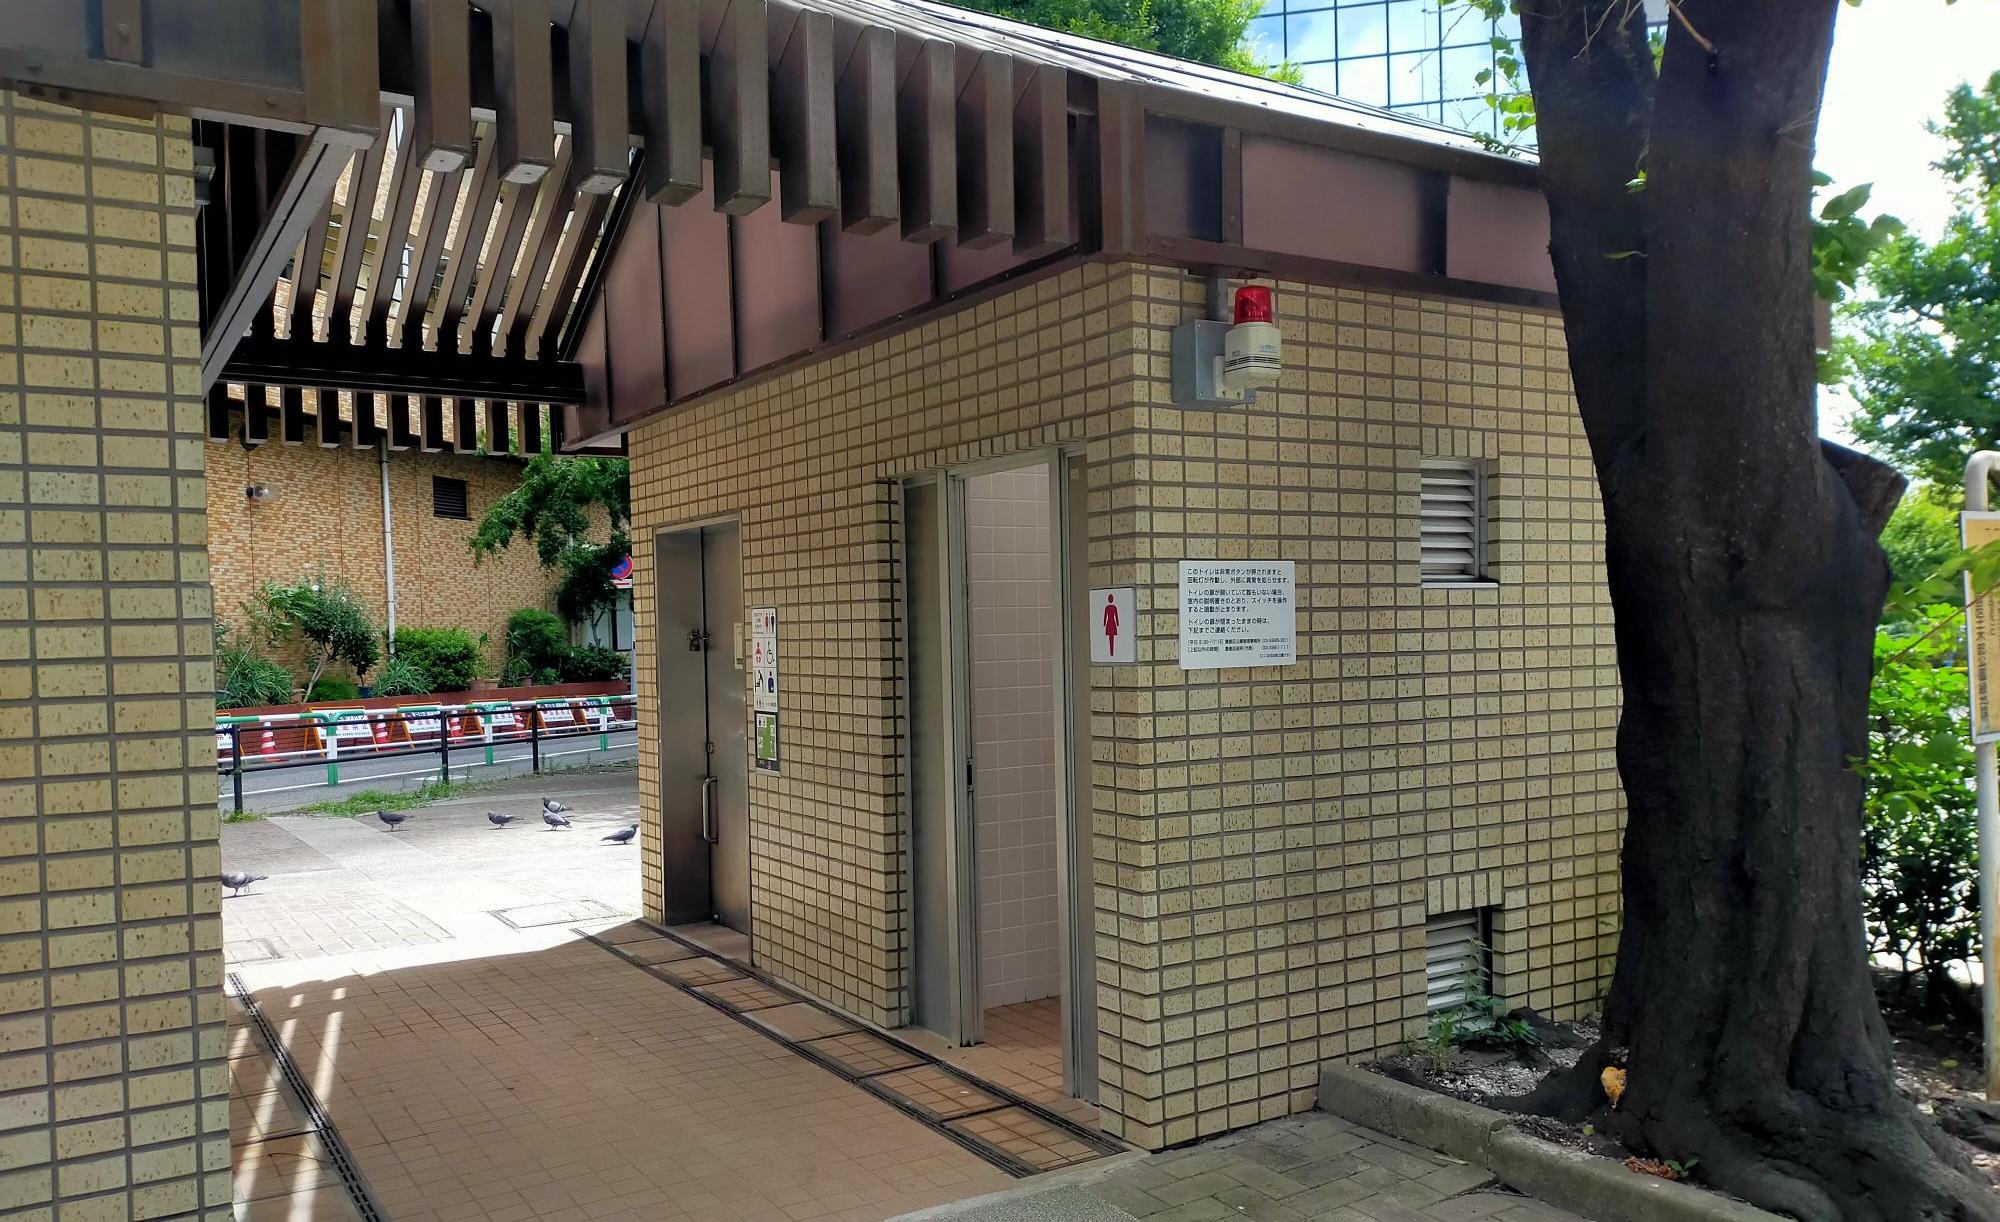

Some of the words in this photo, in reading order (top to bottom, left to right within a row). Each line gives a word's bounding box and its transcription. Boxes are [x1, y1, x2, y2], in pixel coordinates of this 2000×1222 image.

[1187, 568, 1282, 576] このトイレは非常ボタンが押されますと
[1187, 576, 1290, 584] 回転灯が作動し、外部に異常を知らせます。
[1187, 597, 1288, 605] 室内の説明書きのとおり、スイッチを操作
[1188, 617, 1269, 625] トイレの扉が閉まったままの時は、
[1188, 626, 1250, 634] 下記までご連絡ください。
